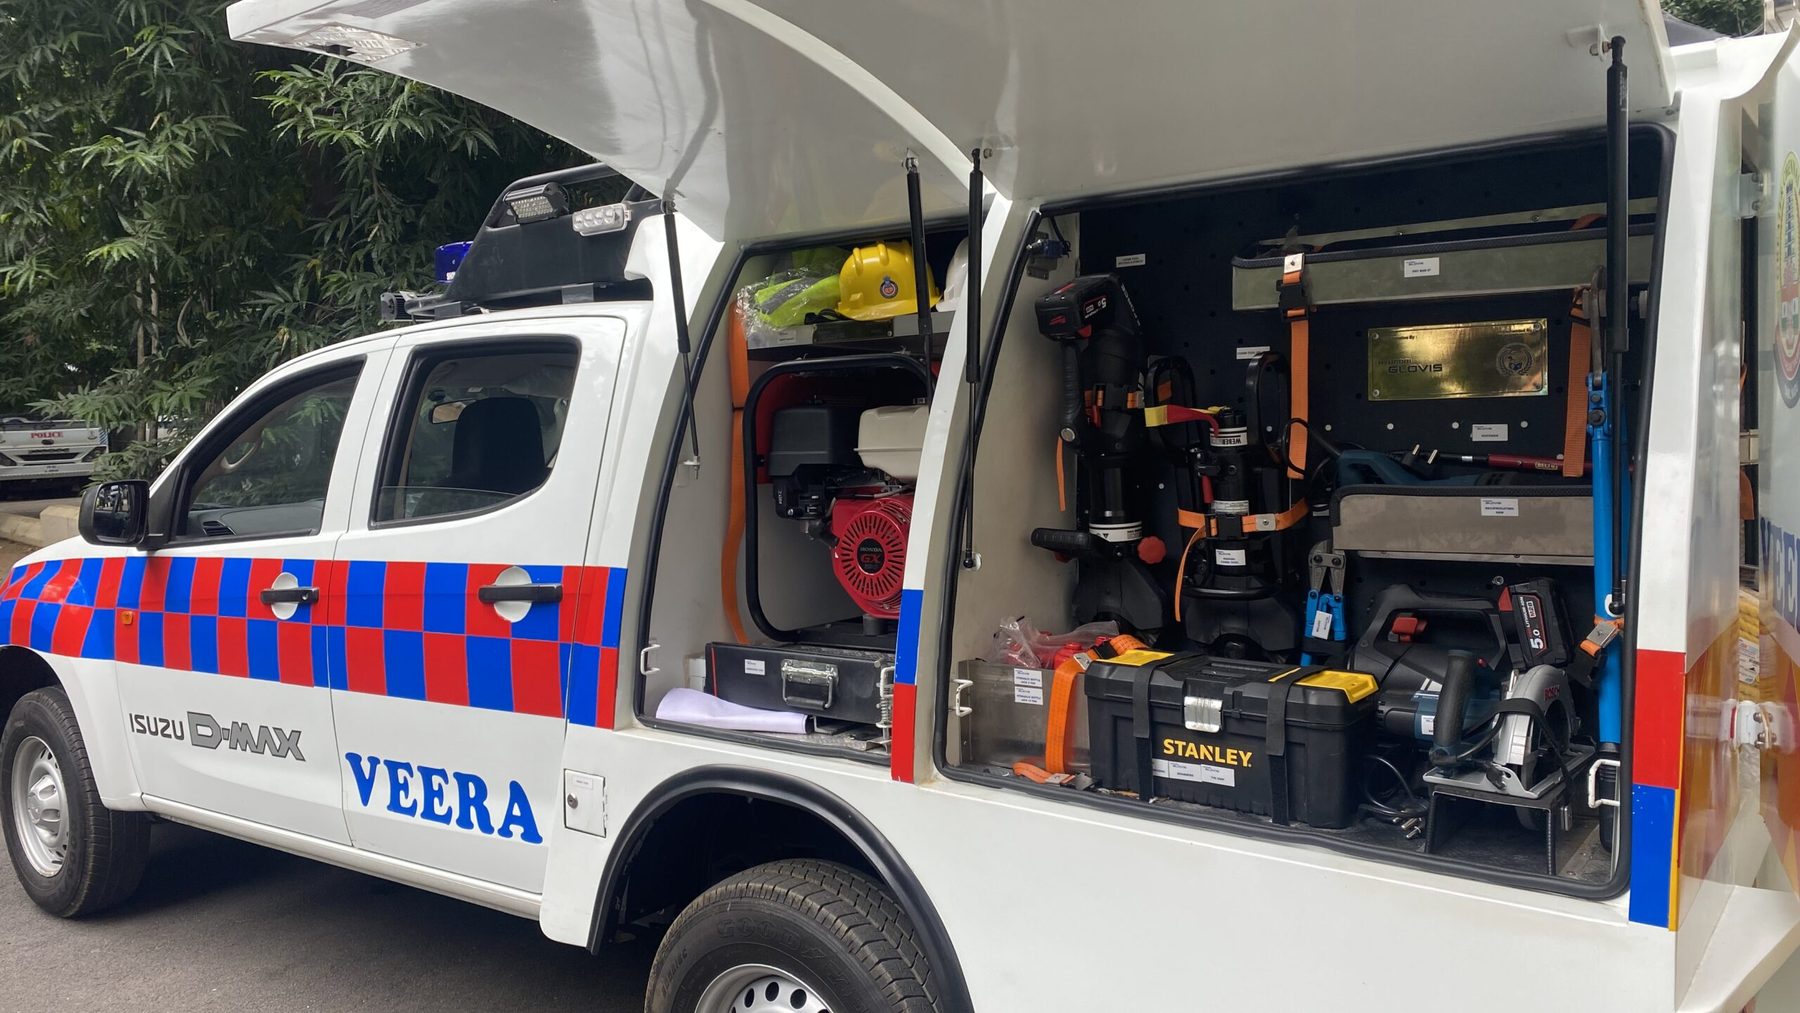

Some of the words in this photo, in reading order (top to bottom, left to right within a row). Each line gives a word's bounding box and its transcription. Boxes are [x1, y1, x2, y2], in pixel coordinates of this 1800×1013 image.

[1388, 364, 1443, 374] GLOVIS
[31, 431, 64, 439] POLICE
[861, 553, 881, 563] GX
[1760, 517, 1800, 634] VEE
[1530, 629, 1544, 649] 5.0
[129, 713, 185, 741] ISUZU
[187, 710, 306, 761] D-MAX
[1163, 738, 1253, 767] STANLEY
[345, 752, 543, 844] VEERA
